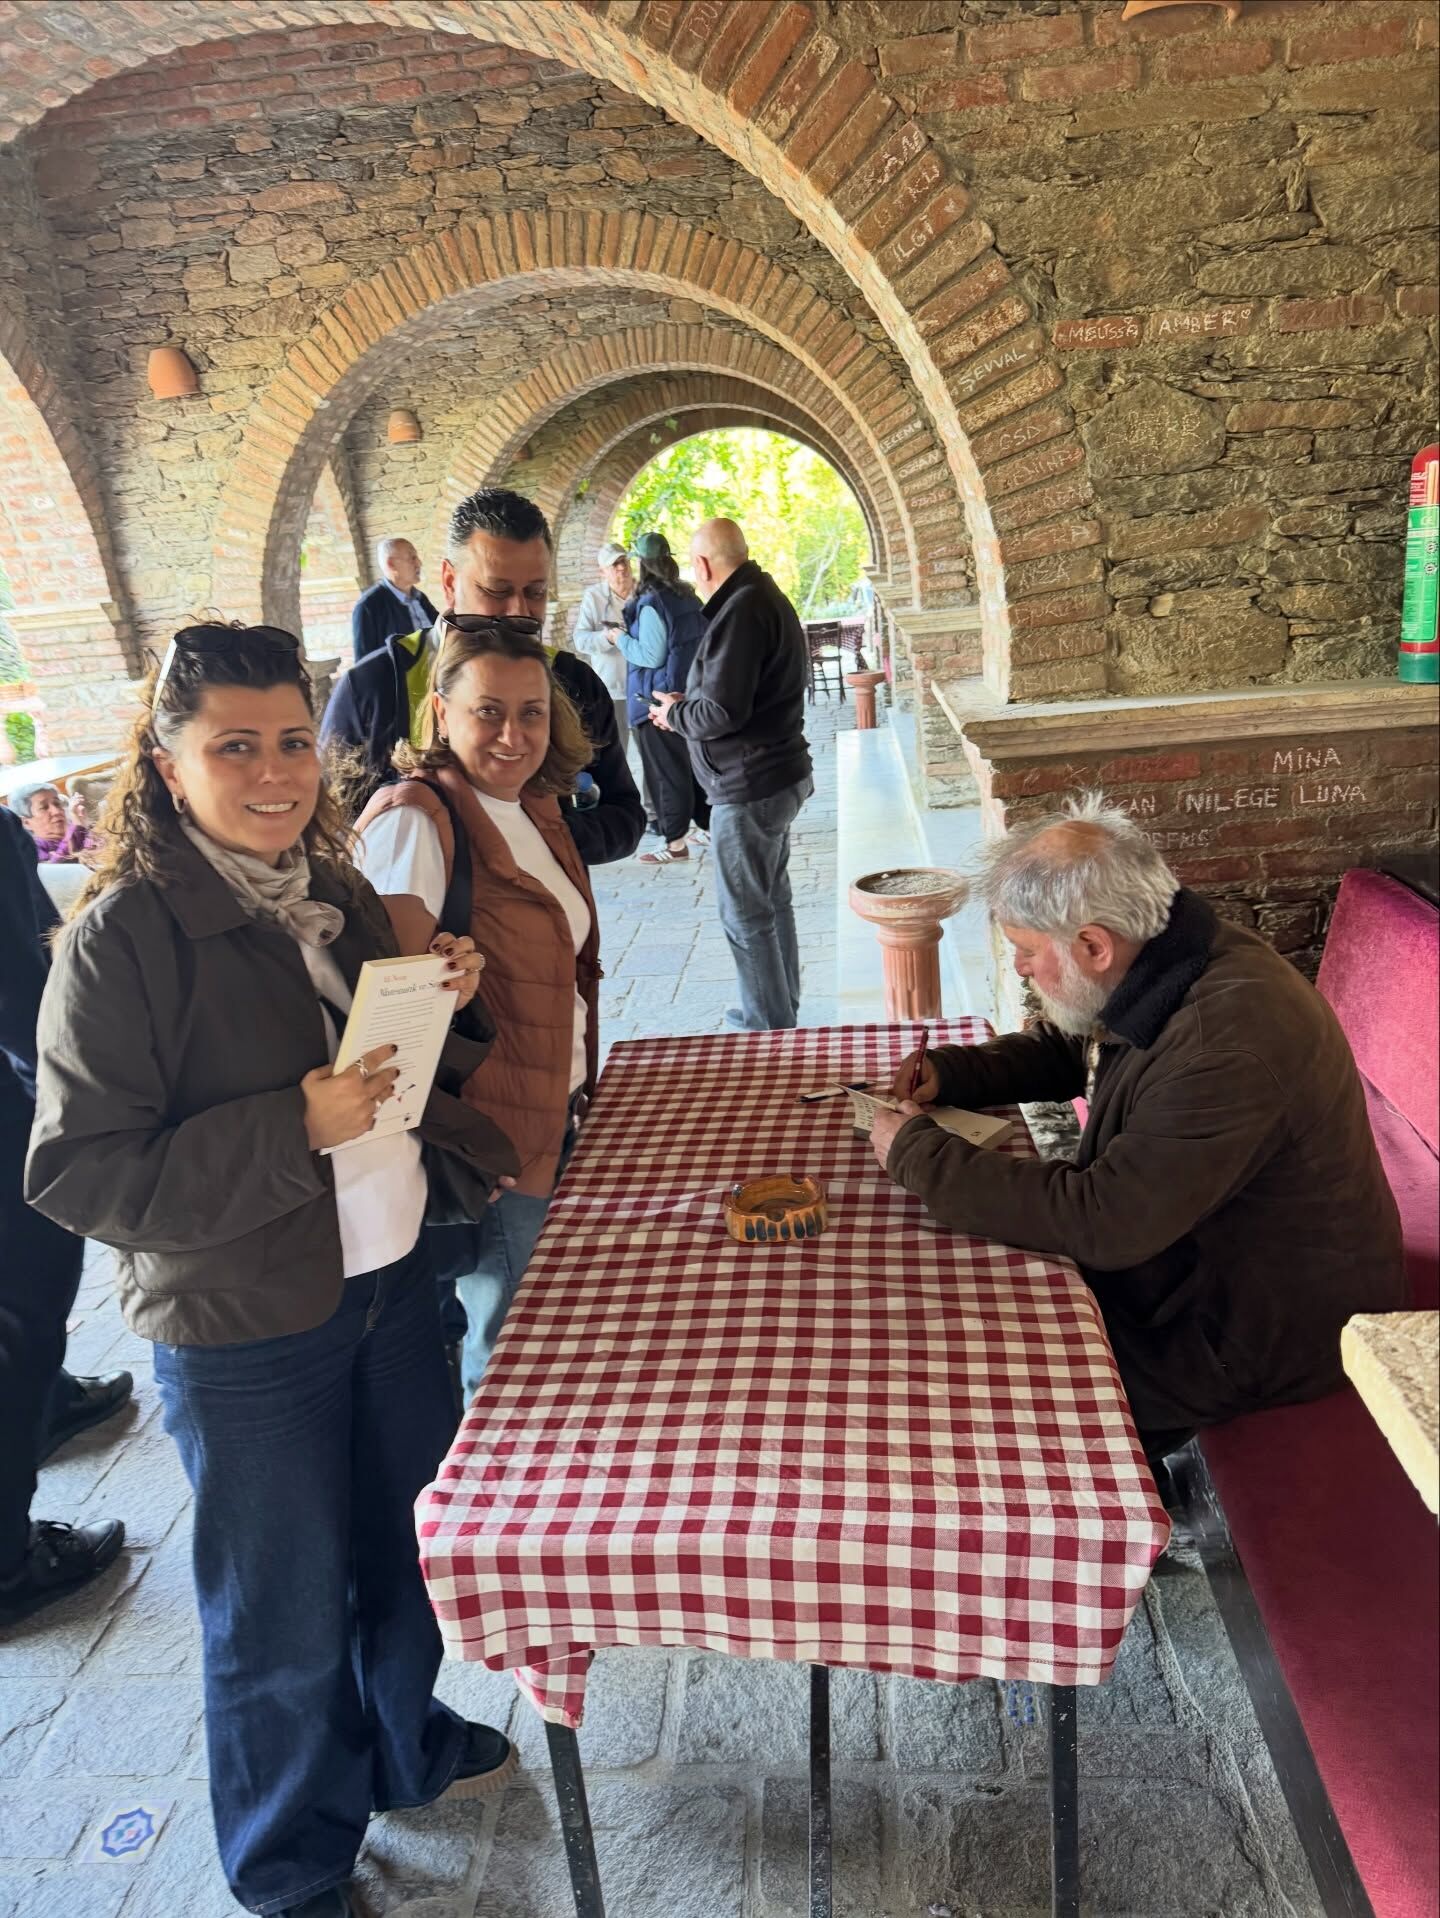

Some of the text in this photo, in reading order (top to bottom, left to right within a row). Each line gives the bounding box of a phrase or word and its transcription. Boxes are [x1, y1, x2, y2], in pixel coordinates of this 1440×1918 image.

[1158, 306, 1238, 335] AMBER
[1272, 747, 1342, 774] MİNA
[1299, 784, 1366, 804] LUNA
